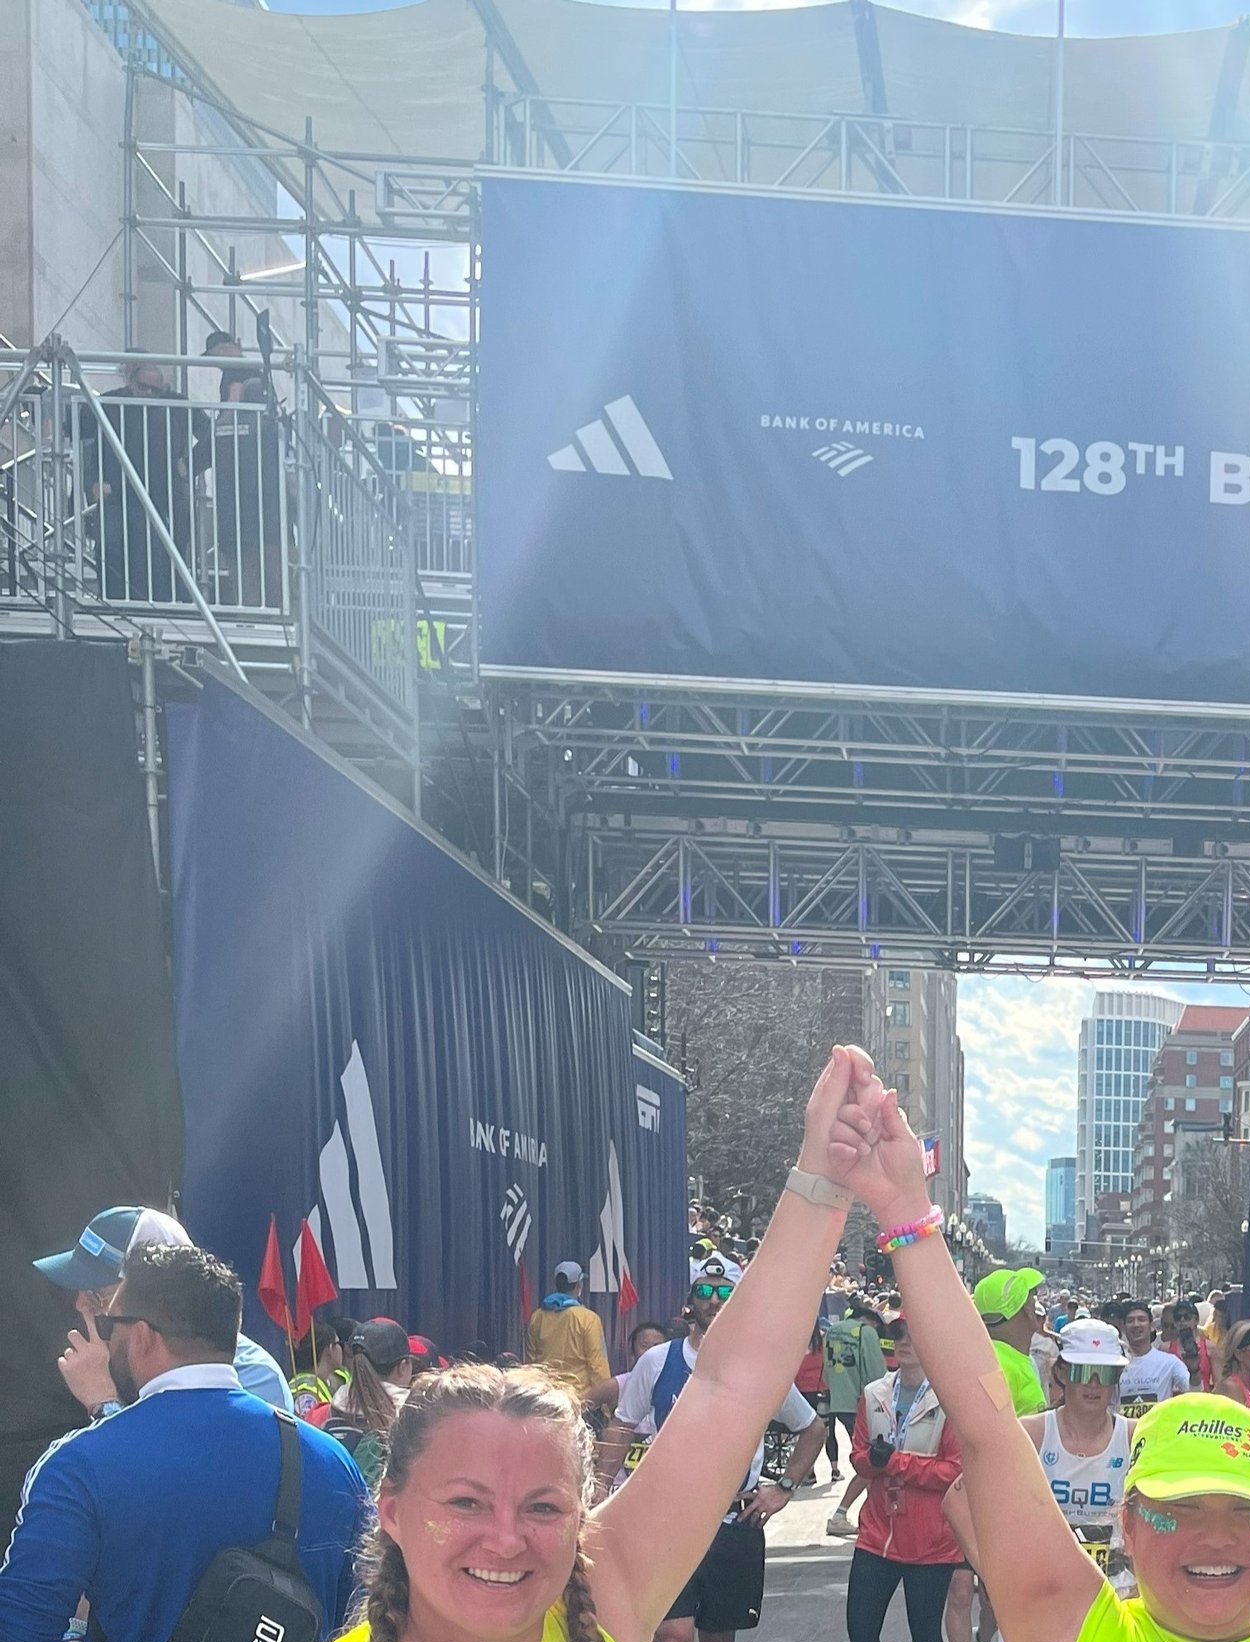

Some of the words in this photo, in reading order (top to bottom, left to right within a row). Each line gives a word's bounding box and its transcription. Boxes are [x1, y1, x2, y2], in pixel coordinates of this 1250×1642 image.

[760, 414, 810, 430] BANK
[815, 418, 838, 432] OF
[842, 420, 925, 440] AMERICA
[1010, 436, 1185, 495] 128TH
[1123, 1404, 1154, 1419] 2730
[1177, 1420, 1243, 1438] Achilles
